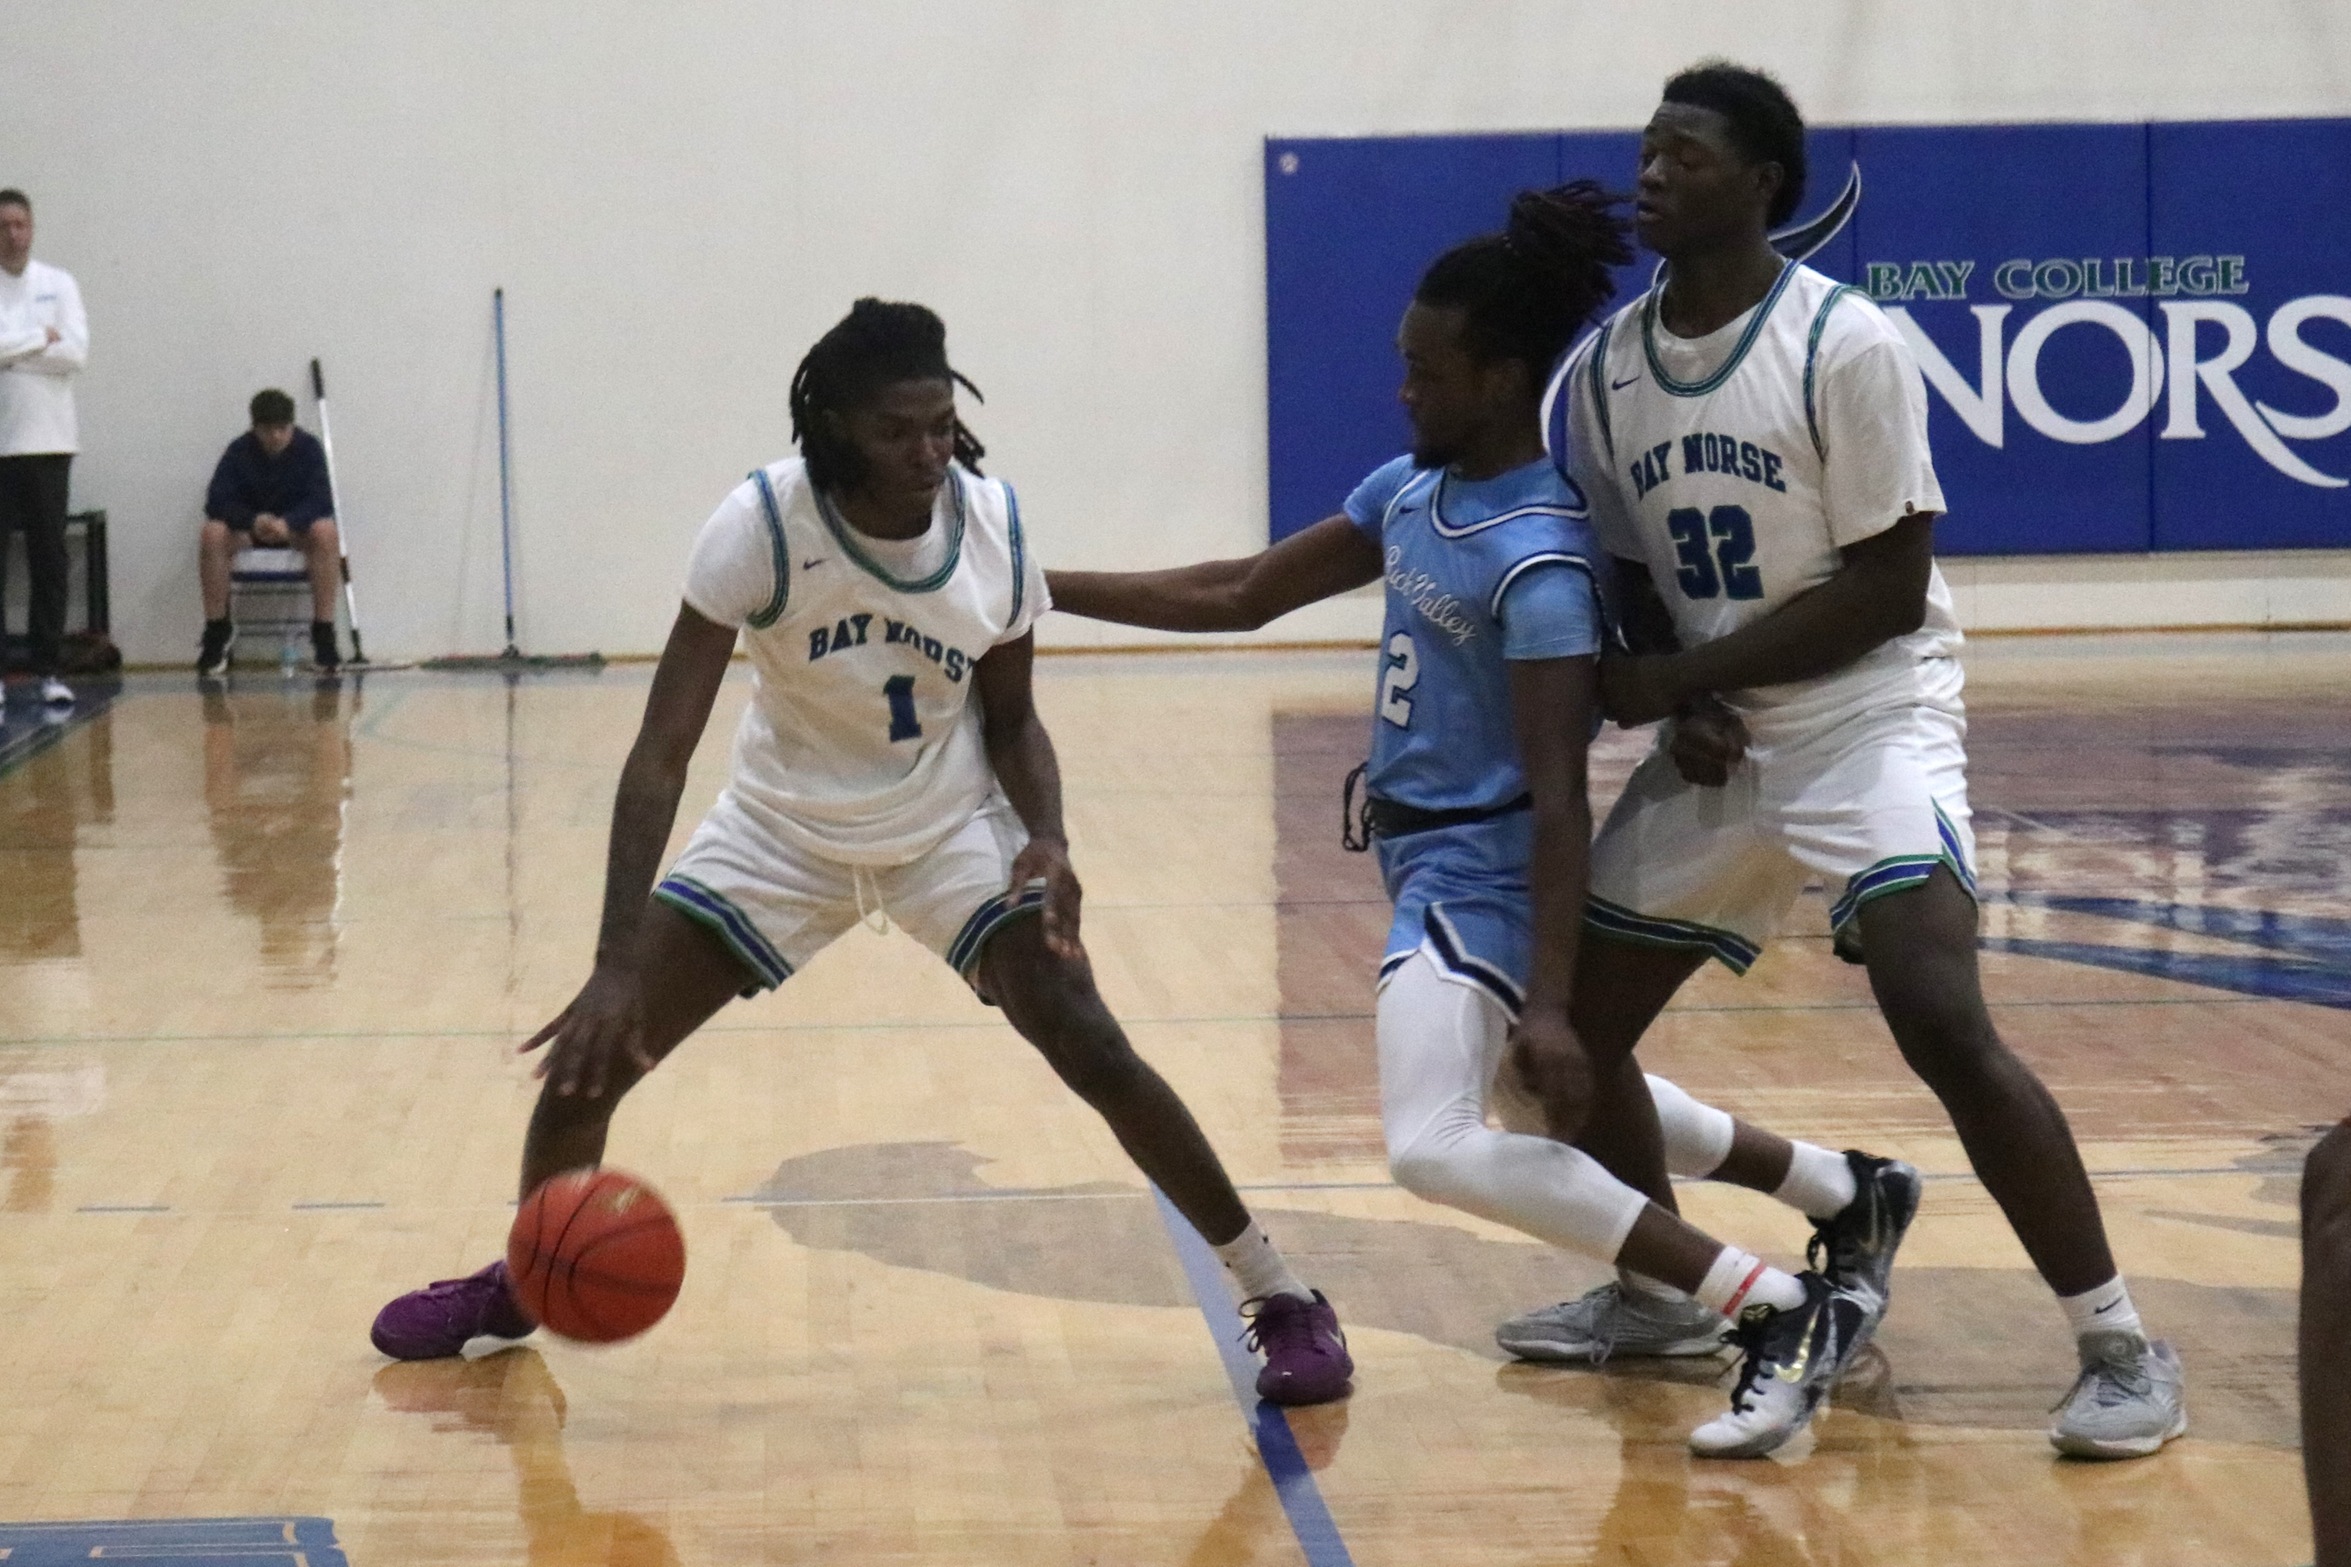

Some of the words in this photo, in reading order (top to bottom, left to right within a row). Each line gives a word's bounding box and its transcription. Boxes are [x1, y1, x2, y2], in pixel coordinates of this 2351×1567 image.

[1867, 261, 1975, 300] BAY
[1995, 255, 2249, 298] COLLEGE
[1630, 440, 1672, 501] BAY
[1681, 432, 1786, 493] NORSE
[1667, 505, 1764, 600] 32
[809, 613, 873, 661] BAY
[884, 616, 975, 683] NORS
[1382, 630, 1419, 729] 2
[883, 674, 922, 742] 1
